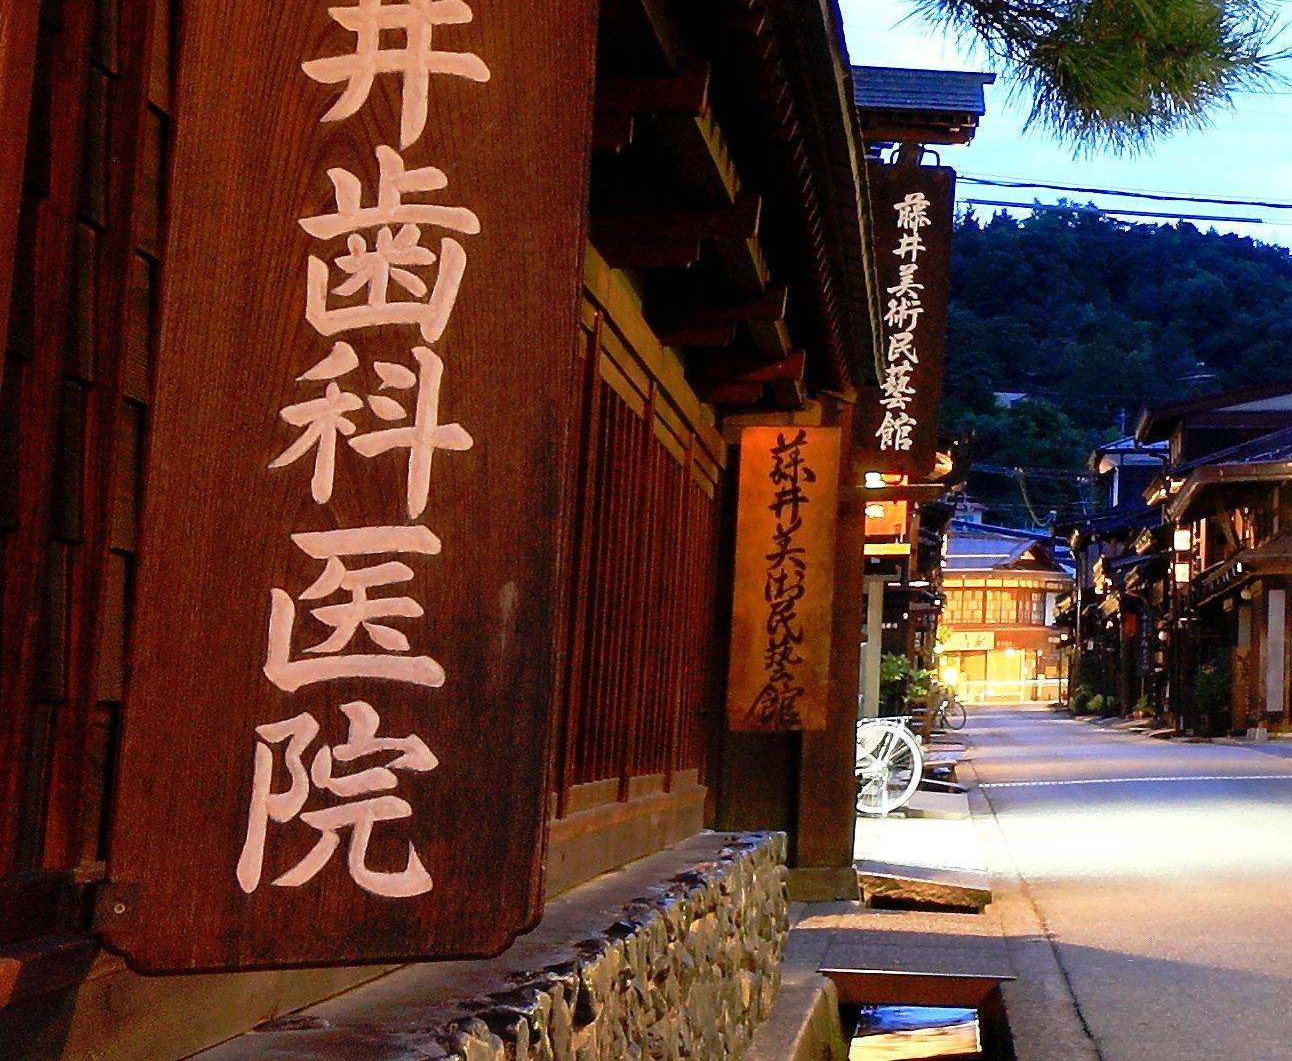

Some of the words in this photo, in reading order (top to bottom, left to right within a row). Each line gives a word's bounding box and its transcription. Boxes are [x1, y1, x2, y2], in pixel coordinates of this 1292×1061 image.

[875, 192, 932, 451] 藤井美術民藝館
